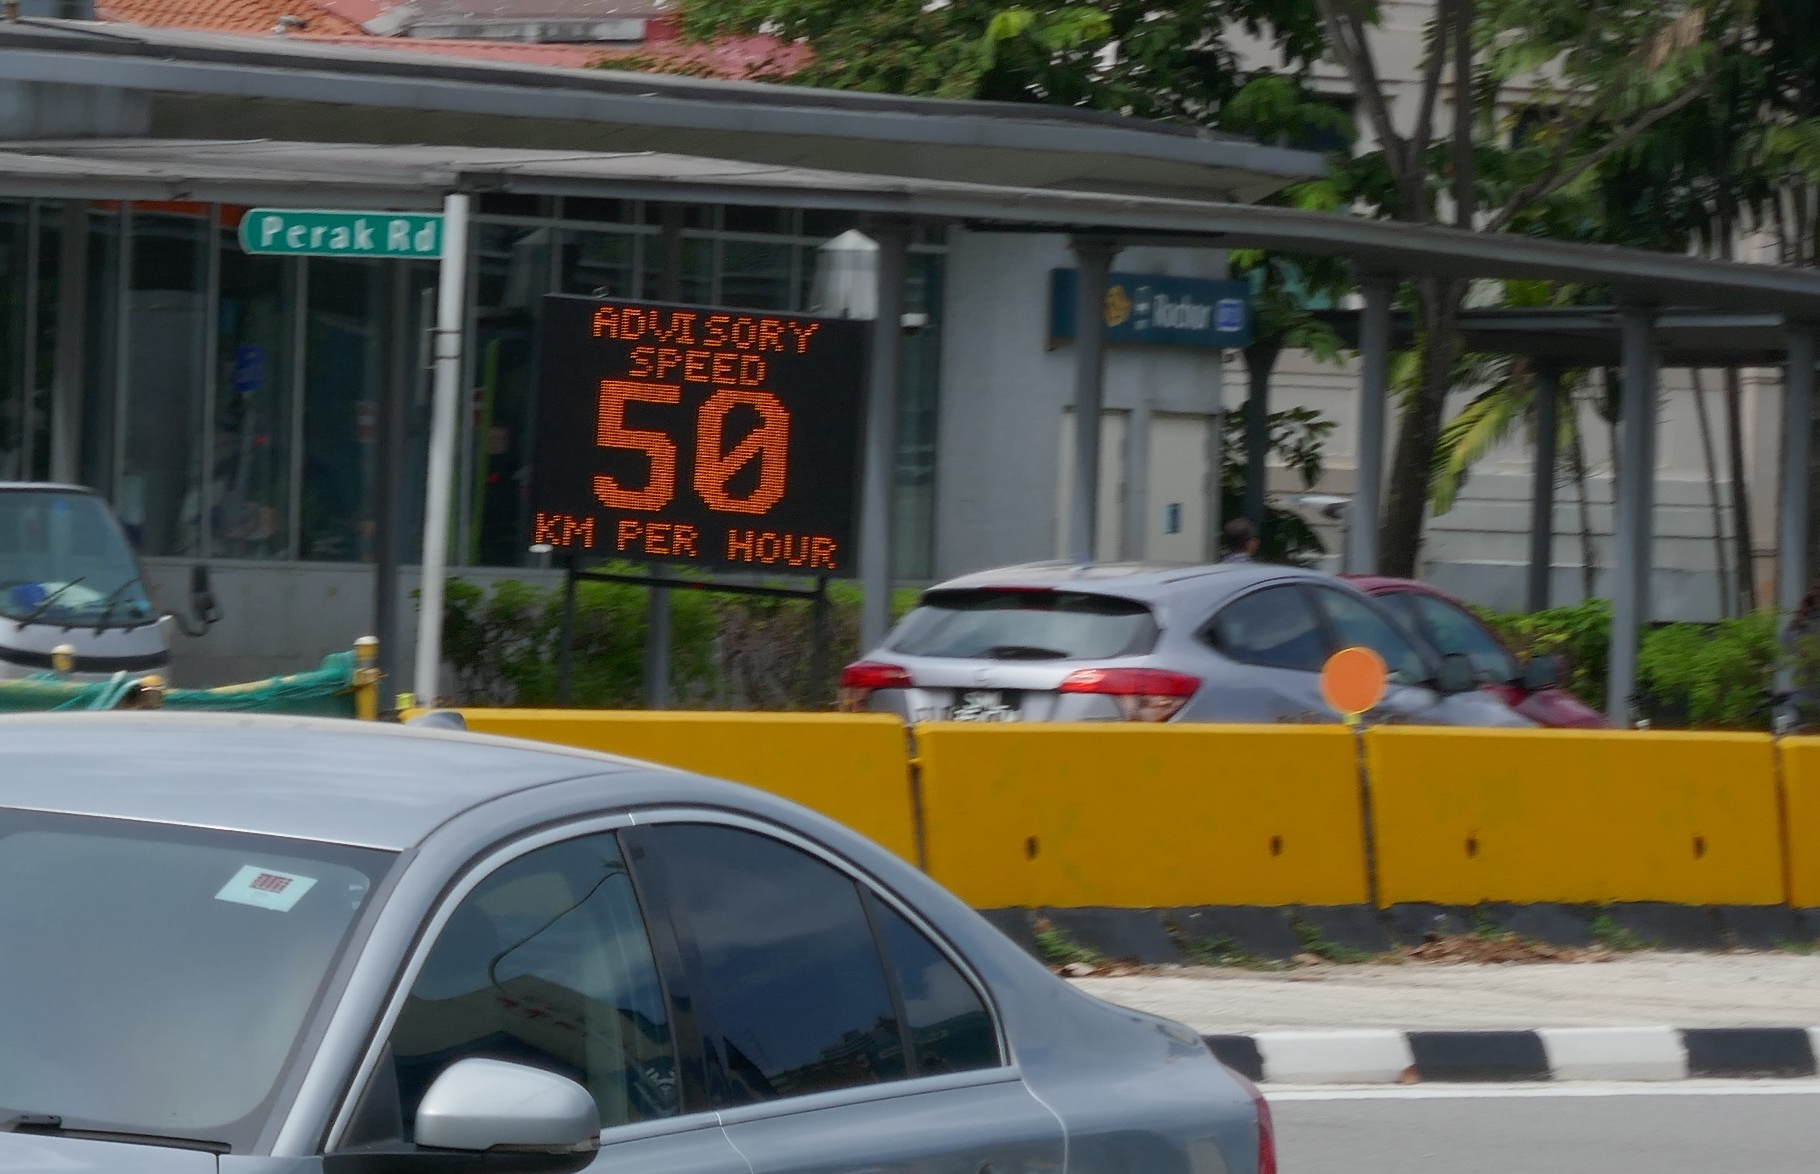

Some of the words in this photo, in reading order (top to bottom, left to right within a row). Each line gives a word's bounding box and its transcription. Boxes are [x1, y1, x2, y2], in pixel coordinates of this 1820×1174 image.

[261, 216, 374, 250] Perak
[388, 219, 437, 252] Rd
[592, 306, 820, 353] ADVISORY
[628, 346, 766, 386] SPEED
[592, 379, 791, 515] 50
[534, 512, 596, 548] KM
[617, 520, 699, 557] PER
[727, 529, 837, 569] HOUR
